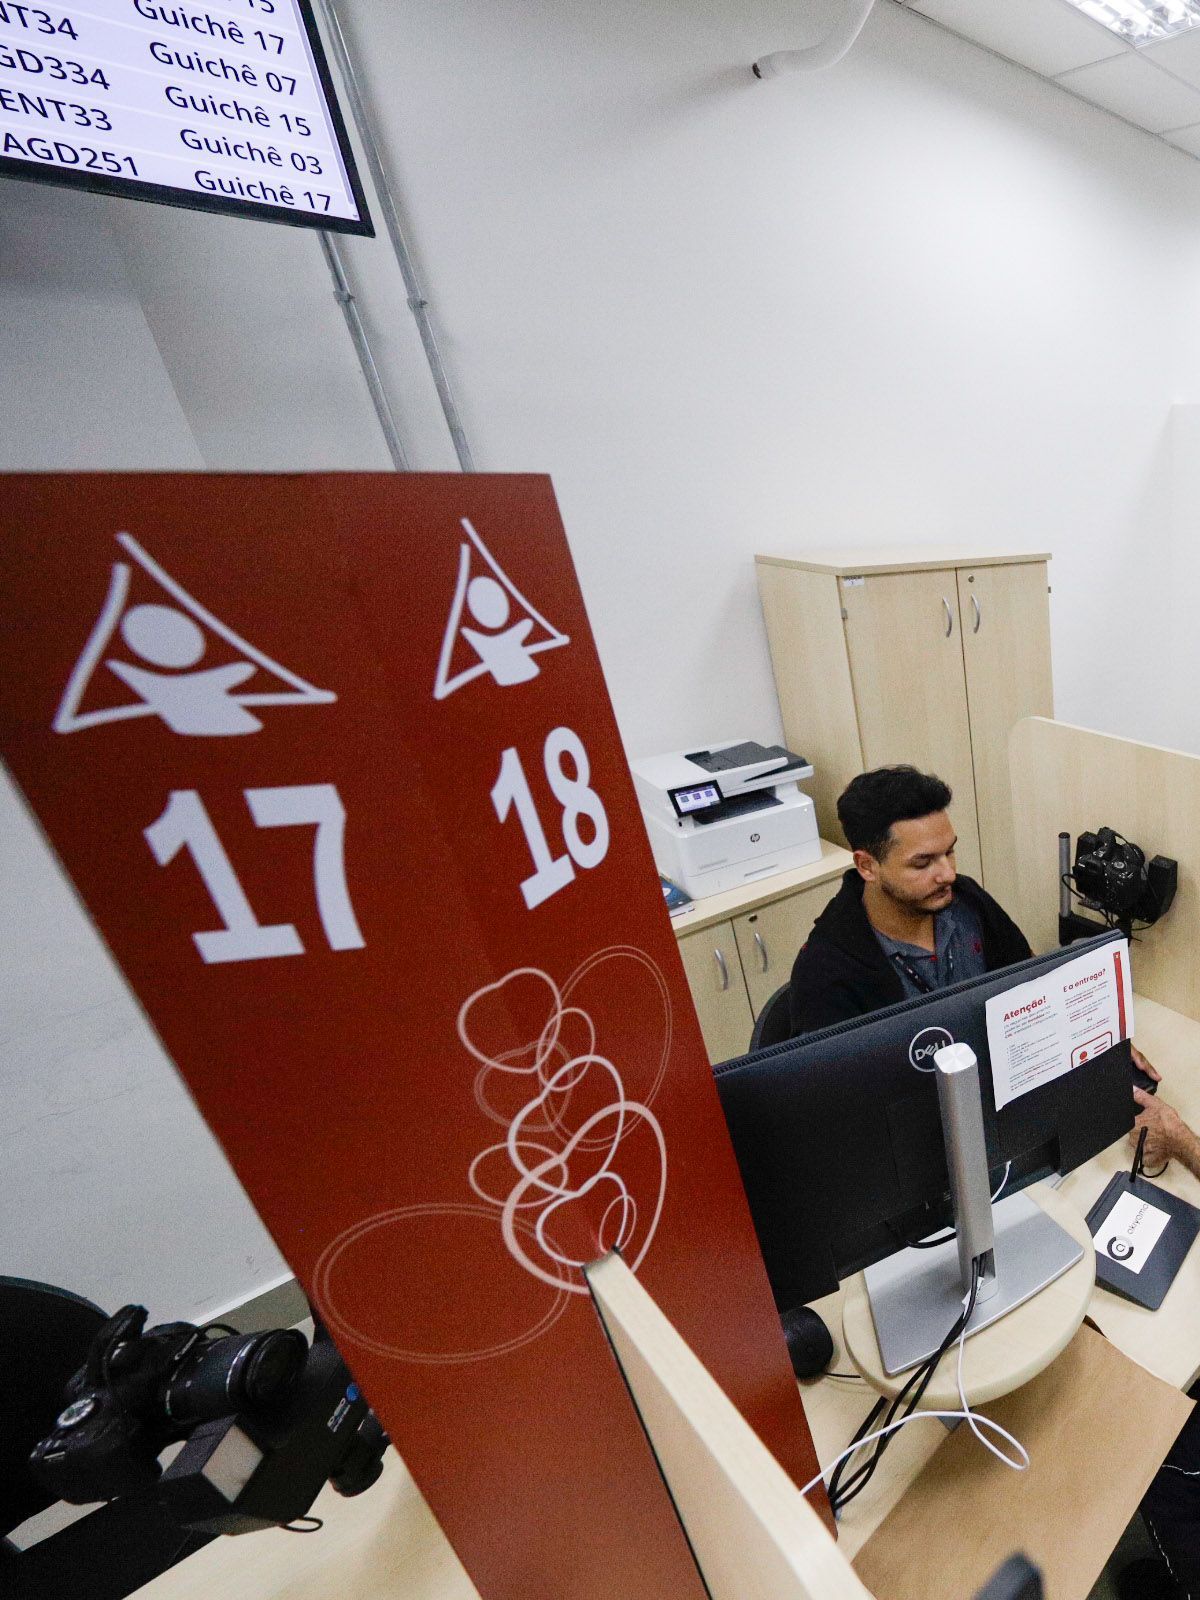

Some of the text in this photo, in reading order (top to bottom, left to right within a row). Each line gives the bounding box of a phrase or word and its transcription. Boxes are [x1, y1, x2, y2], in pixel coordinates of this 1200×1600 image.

[134, 0, 284, 55] Guichê 17
[150, 42, 258, 87] Guichê
[266, 72, 297, 96] 07
[0, 88, 323, 175] ENT33 Guichê 03
[165, 86, 270, 127] Guichê
[279, 113, 311, 136] 15
[3, 132, 331, 212] AGD251 Guichê 17
[490, 726, 609, 910] 18
[143, 783, 366, 964] 17
[1003, 995, 1047, 1022] Atenção!
